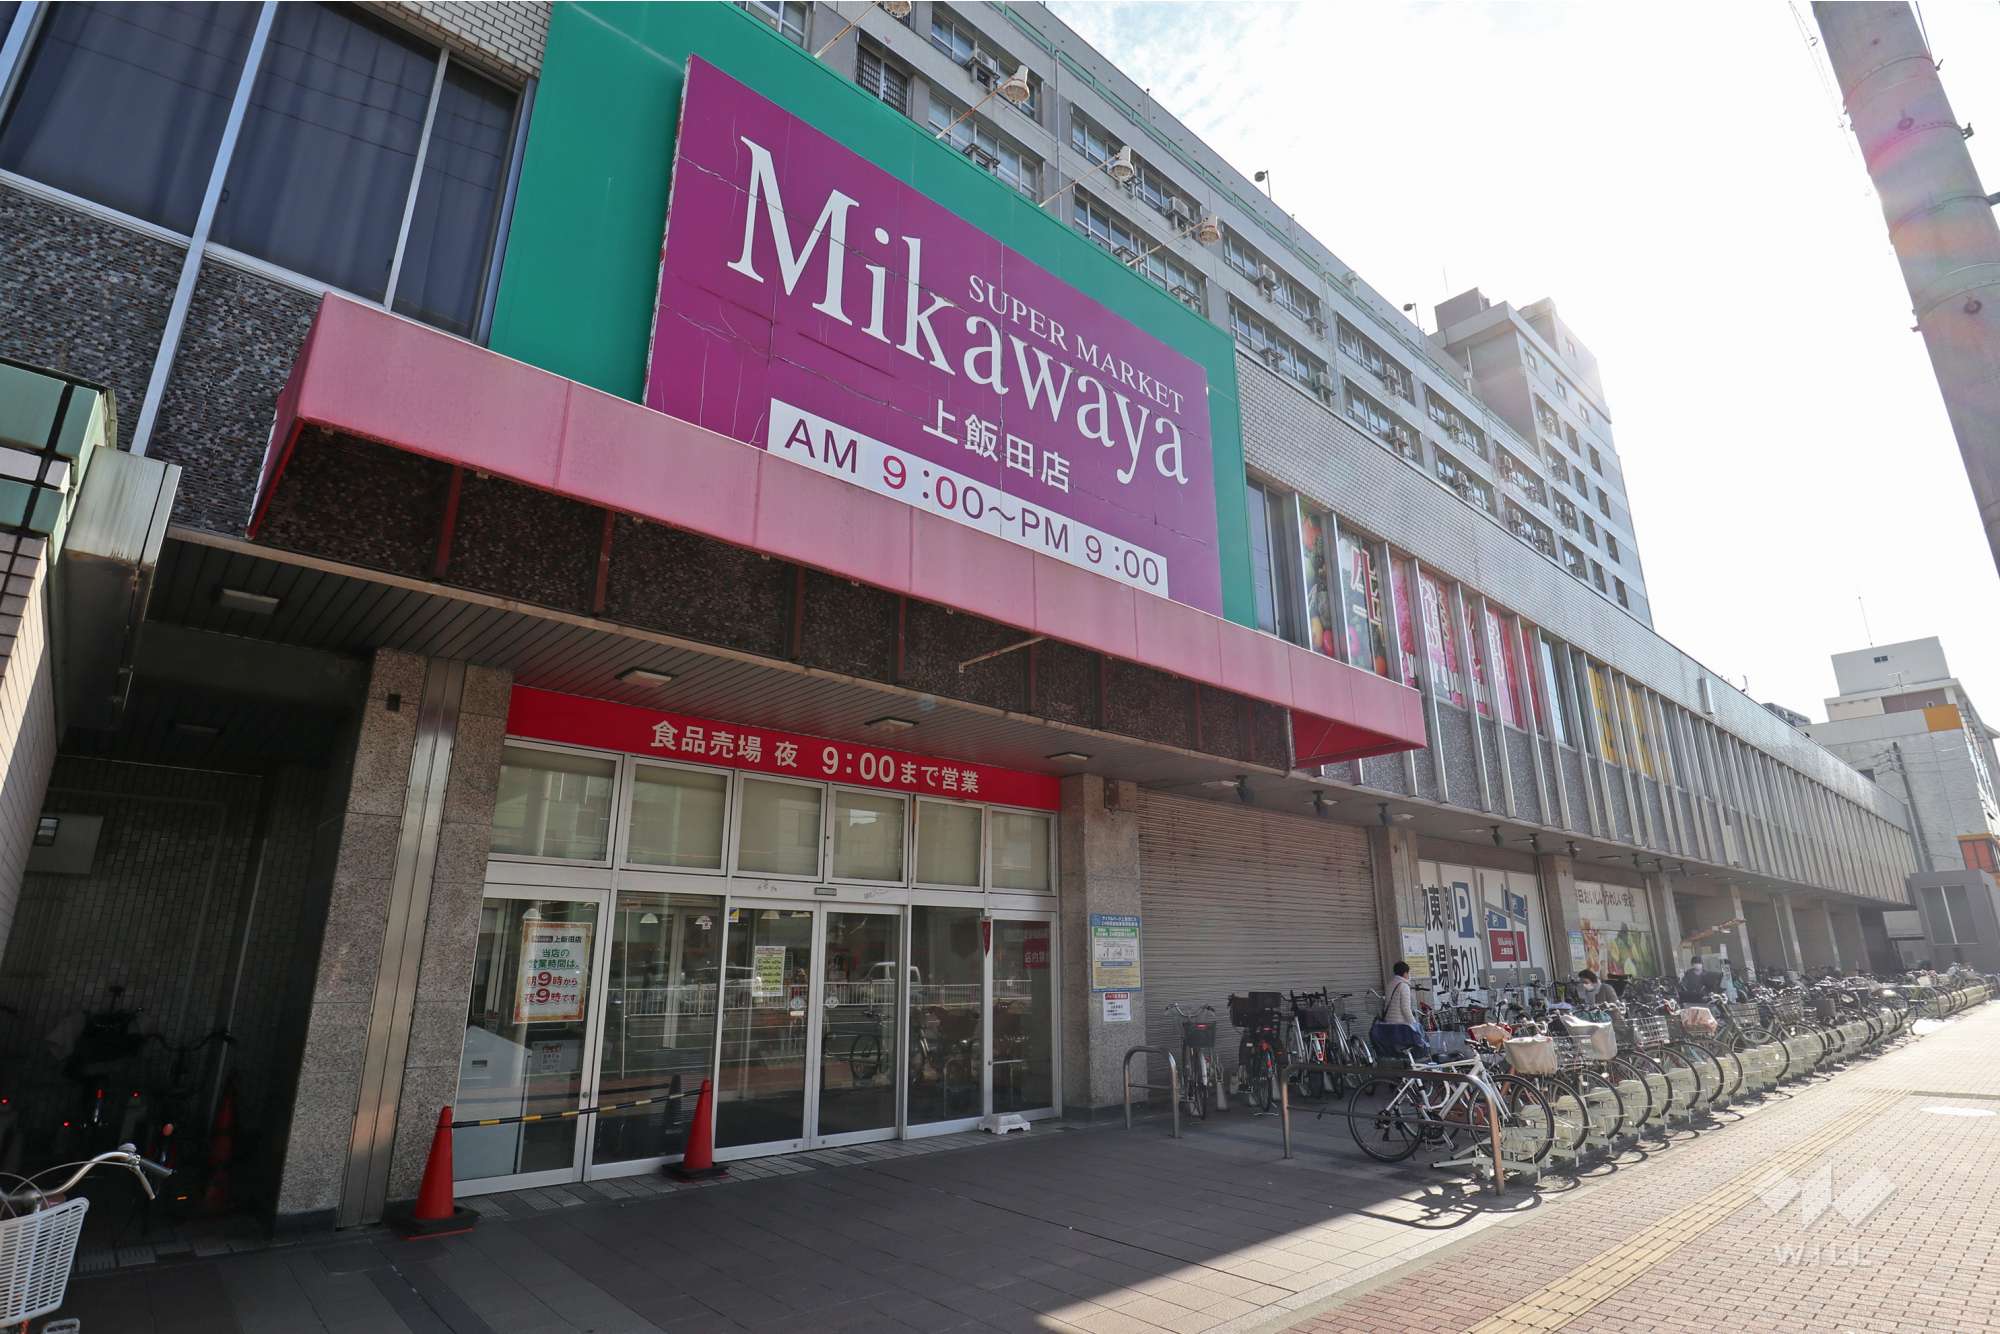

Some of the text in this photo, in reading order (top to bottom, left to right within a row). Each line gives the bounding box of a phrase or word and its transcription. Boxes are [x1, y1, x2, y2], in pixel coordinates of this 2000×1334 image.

[727, 136, 1189, 485] Mikawaya
[968, 273, 1184, 415] SUPER MARKET
[784, 418, 858, 474] AM
[923, 400, 1071, 494] 上飯田店
[650, 720, 763, 764] 食品売場
[774, 740, 799, 769] 夜
[542, 948, 570, 958] 当店の
